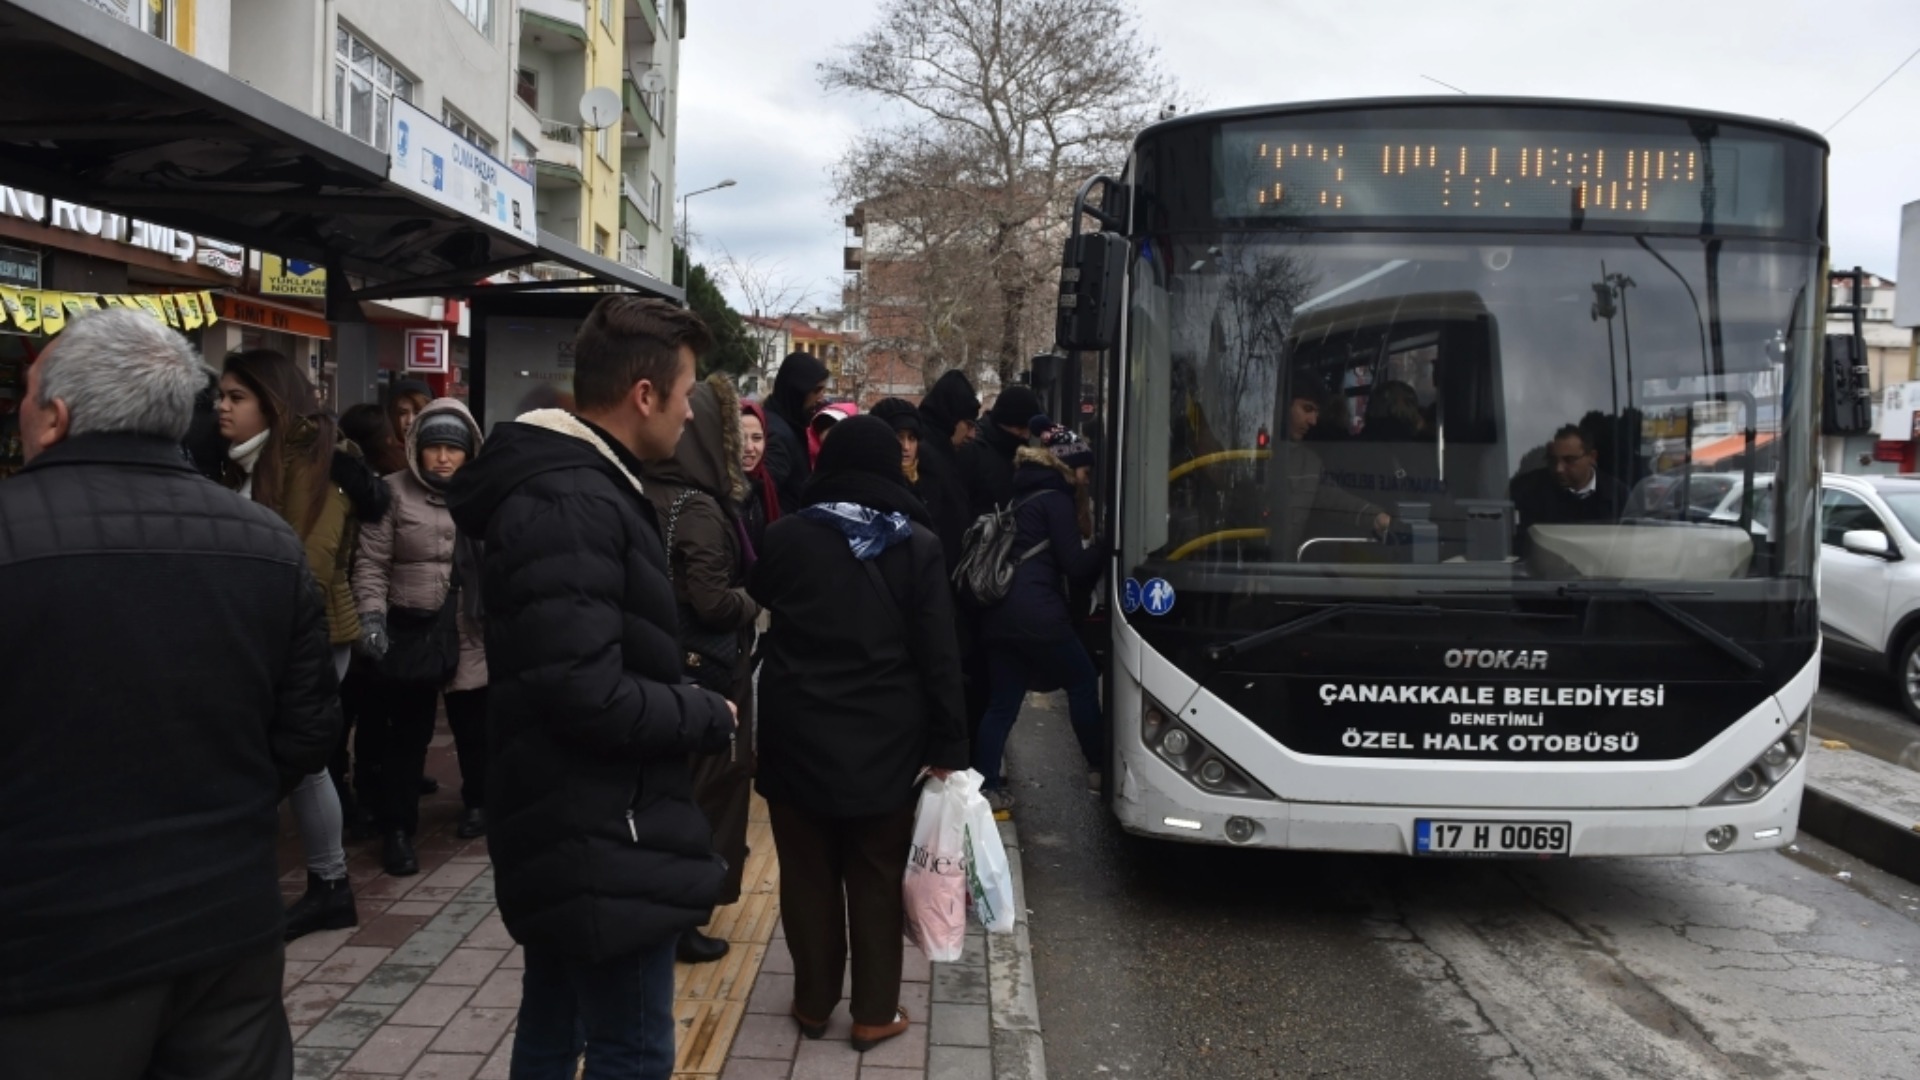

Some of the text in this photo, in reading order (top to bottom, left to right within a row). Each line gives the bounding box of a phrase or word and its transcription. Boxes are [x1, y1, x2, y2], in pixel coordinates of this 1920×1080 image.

[415, 337, 437, 364] E
[1444, 649, 1549, 670] OTOKAR
[1319, 684, 1664, 706] ÇANAKKALE BELEDİYESİ
[1450, 712, 1544, 727] DENETİMLİ
[1341, 728, 1639, 753] ÖZEL HALK OTOBÜSÜ
[1435, 824, 1565, 850] 17 H 0069
